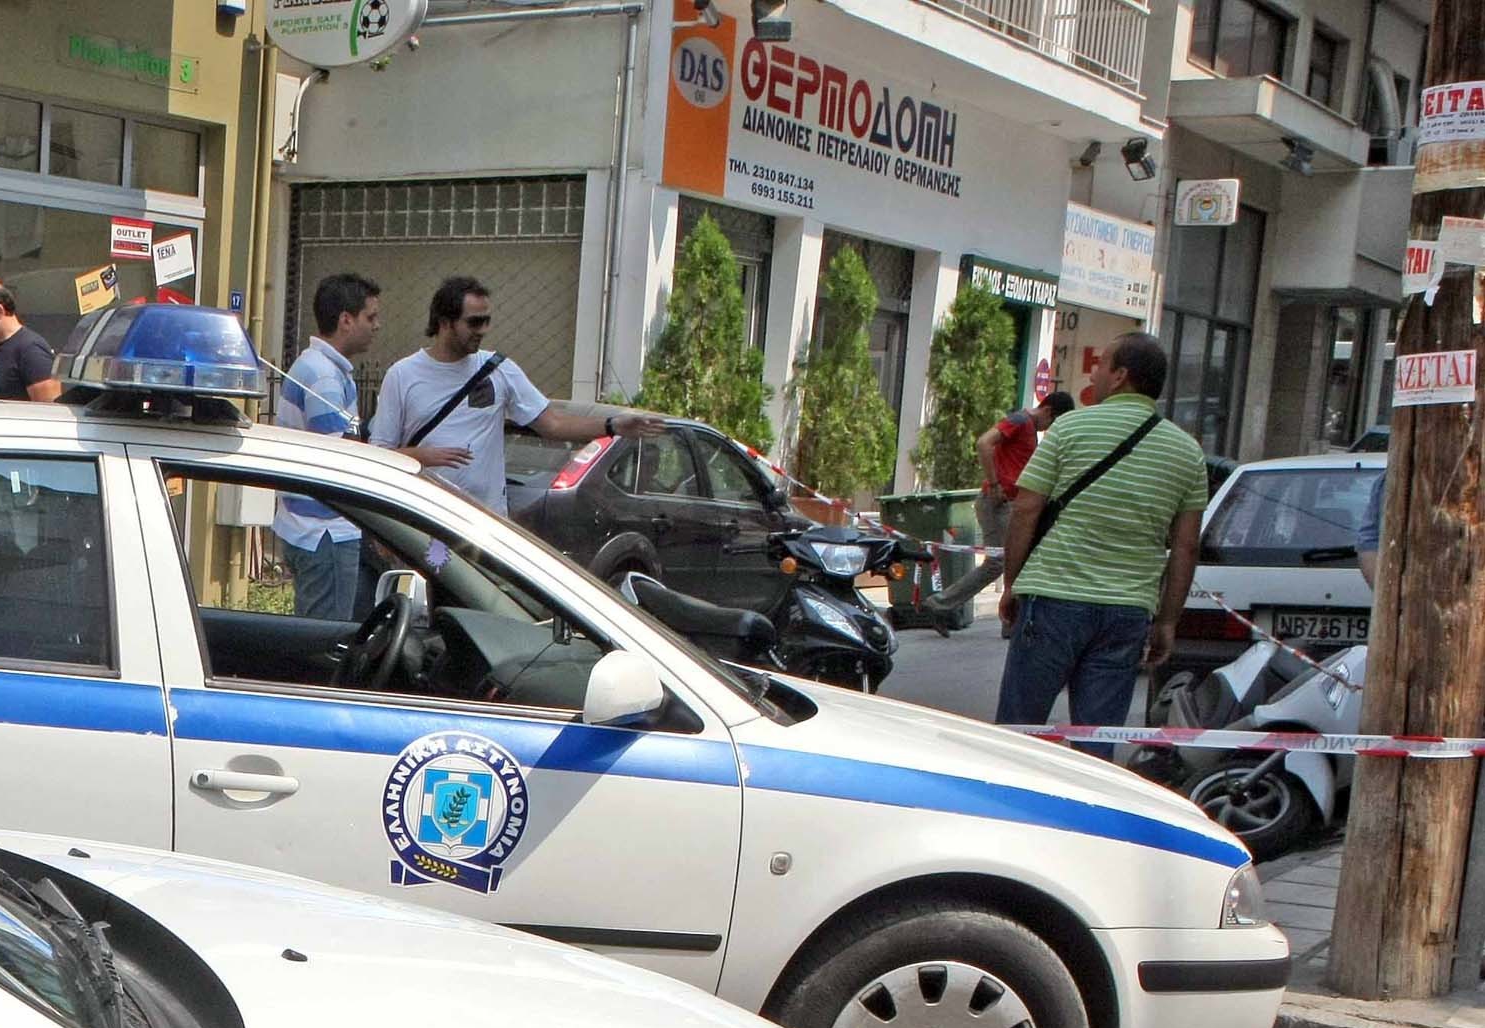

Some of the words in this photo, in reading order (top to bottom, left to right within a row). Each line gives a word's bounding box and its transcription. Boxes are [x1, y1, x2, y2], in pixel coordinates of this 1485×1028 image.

[180, 58, 193, 84] 3
[680, 47, 724, 92] DAS
[741, 37, 957, 168] ΘΕΡΜΟΔΟΜΗ
[742, 106, 812, 152] ΔΙΑΝΟΜΕΣ
[817, 132, 891, 177] ΠΕΤΡΕΛΑΙΟΥ
[894, 158, 961, 197] ΘΕΡΜΑΝΣΗΣ
[729, 159, 750, 175] ΤΗΛ.
[752, 165, 775, 182] 2310
[777, 172, 814, 192] 847.134
[751, 183, 775, 200] 6993
[777, 190, 814, 209] 155.211
[116, 228, 147, 239] OUTLET
[232, 294, 241, 307] 17
[386, 738, 447, 851] ΕΛΛΗΝΙΚΗ
[454, 738, 525, 858] ΑΣΤΥΝΟΜΙΑ
